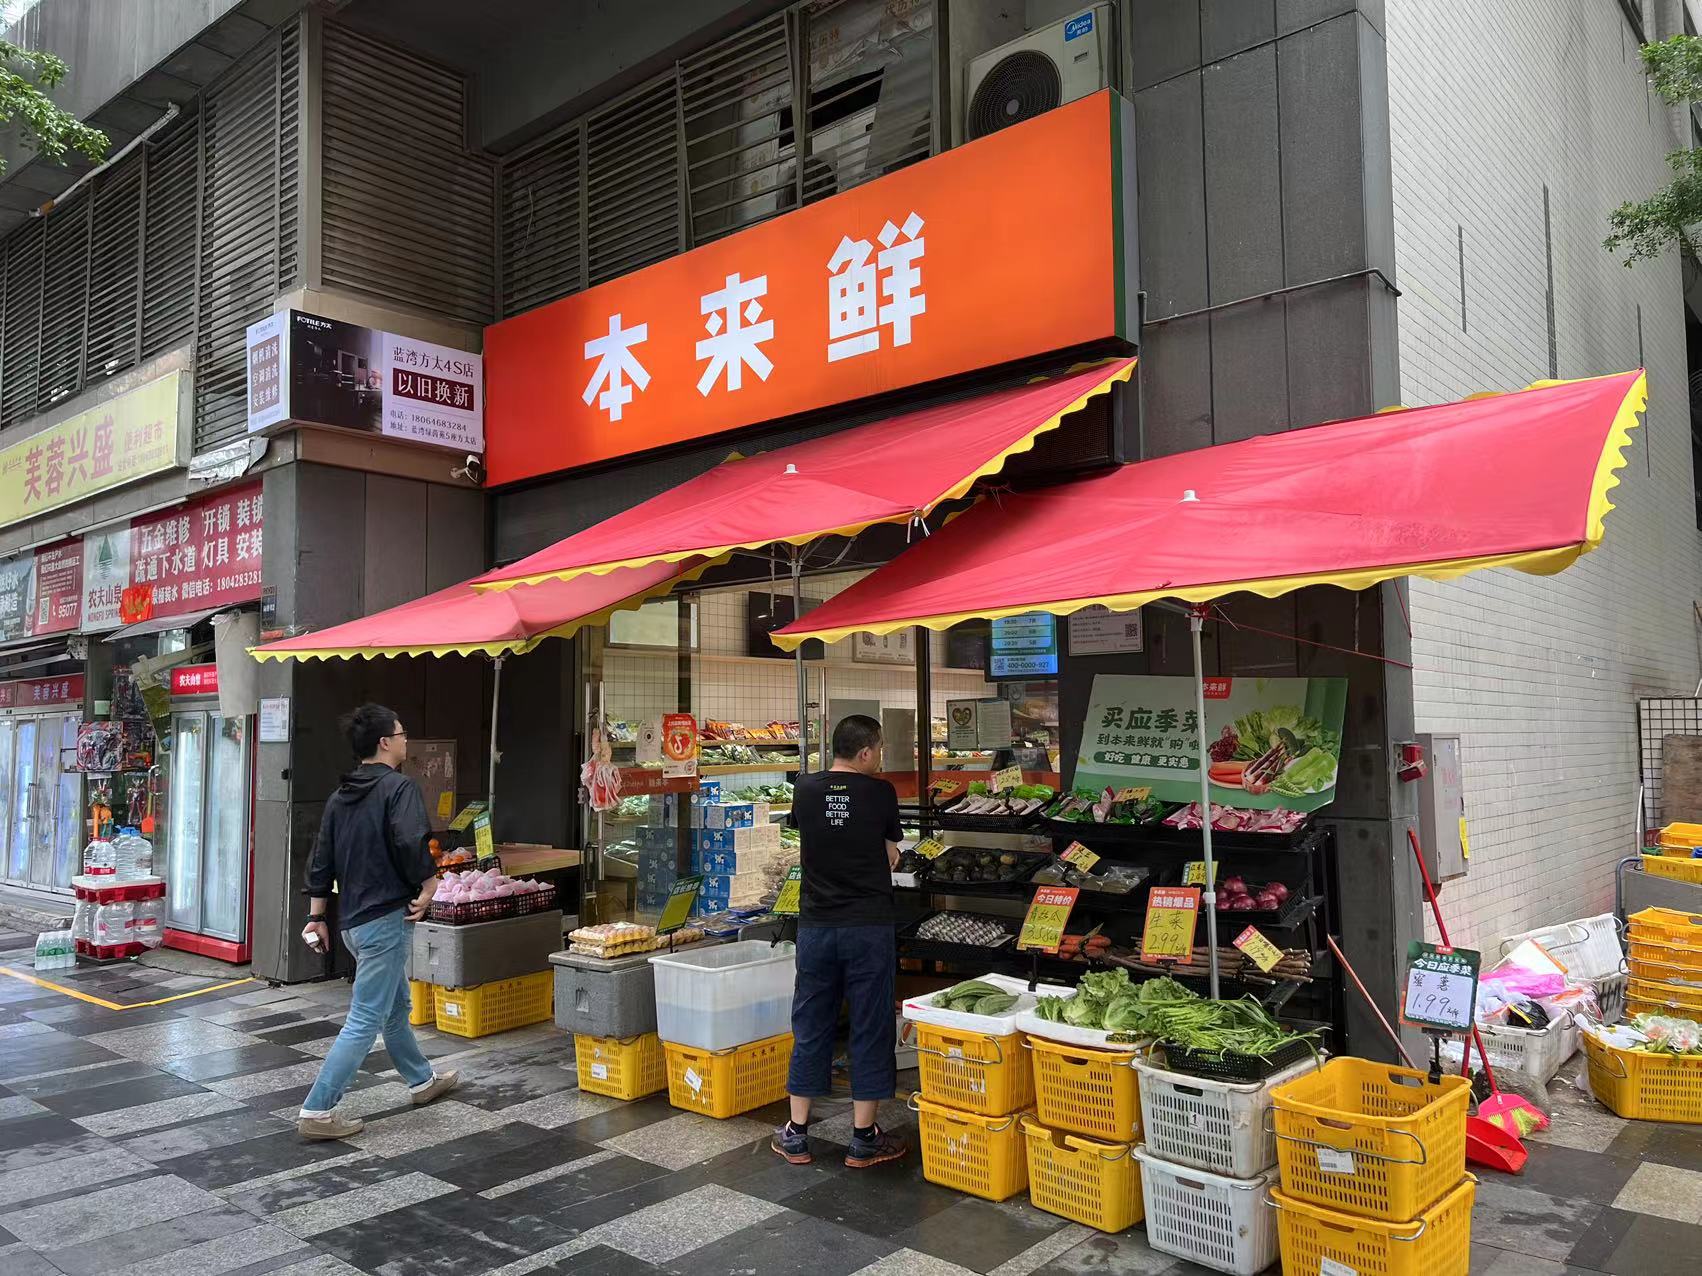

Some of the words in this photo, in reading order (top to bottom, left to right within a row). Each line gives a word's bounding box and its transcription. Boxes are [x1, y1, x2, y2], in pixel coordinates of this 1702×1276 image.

[1067, 19, 1091, 34] Midea
[297, 316, 320, 326] FOTILE
[582, 211, 926, 422] 本来鲜
[393, 346, 474, 378] 蓝湾方太4S店
[398, 372, 469, 407] 以旧换新
[124, 421, 164, 453] 便利超市
[24, 415, 114, 505] 芙蓉兴盛
[142, 515, 191, 553] 五金维修
[204, 504, 230, 537] 开锁
[135, 545, 196, 583] 疏通下水道
[202, 537, 229, 569] 灯具
[237, 528, 262, 561] 安装
[88, 583, 122, 609] 农夫山泉
[59, 603, 78, 618] 95077
[1101, 707, 1206, 734] 买应季菜
[1104, 751, 1125, 763] 好吃
[1131, 753, 1151, 766] 健康
[1156, 756, 1189, 768] 更实惠
[825, 795, 850, 803] BETTER
[1037, 894, 1073, 905] 今日特价
[1152, 896, 1194, 908] 热销爆品
[1149, 910, 1184, 930] 生菜
[1414, 958, 1472, 976] 今日应季菜
